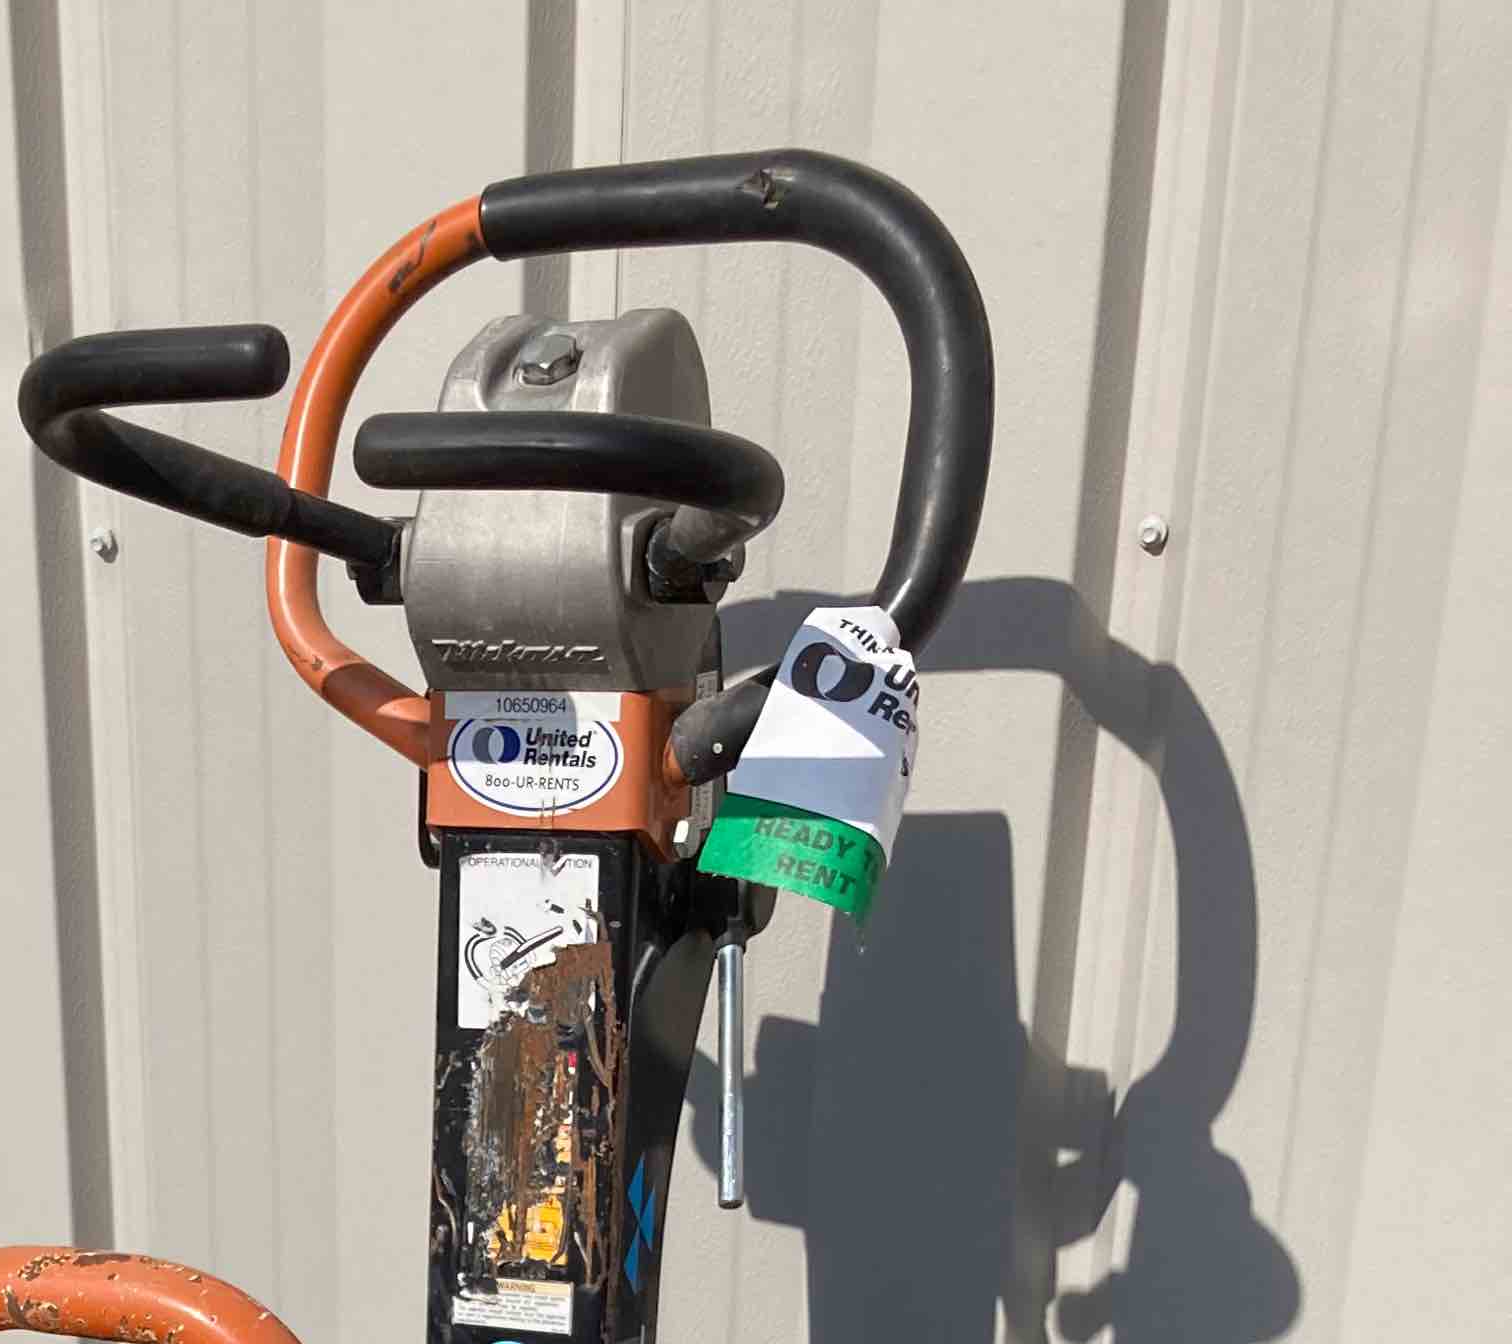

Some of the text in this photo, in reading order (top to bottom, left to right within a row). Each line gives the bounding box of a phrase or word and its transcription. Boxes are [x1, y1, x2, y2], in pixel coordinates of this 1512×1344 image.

[495, 697, 567, 715] 10650964
[524, 727, 594, 749] United
[522, 747, 597, 769] Rentals
[484, 774, 581, 792] 800-UR-RENTS
[755, 817, 856, 858] READY
[776, 855, 856, 895] RENT
